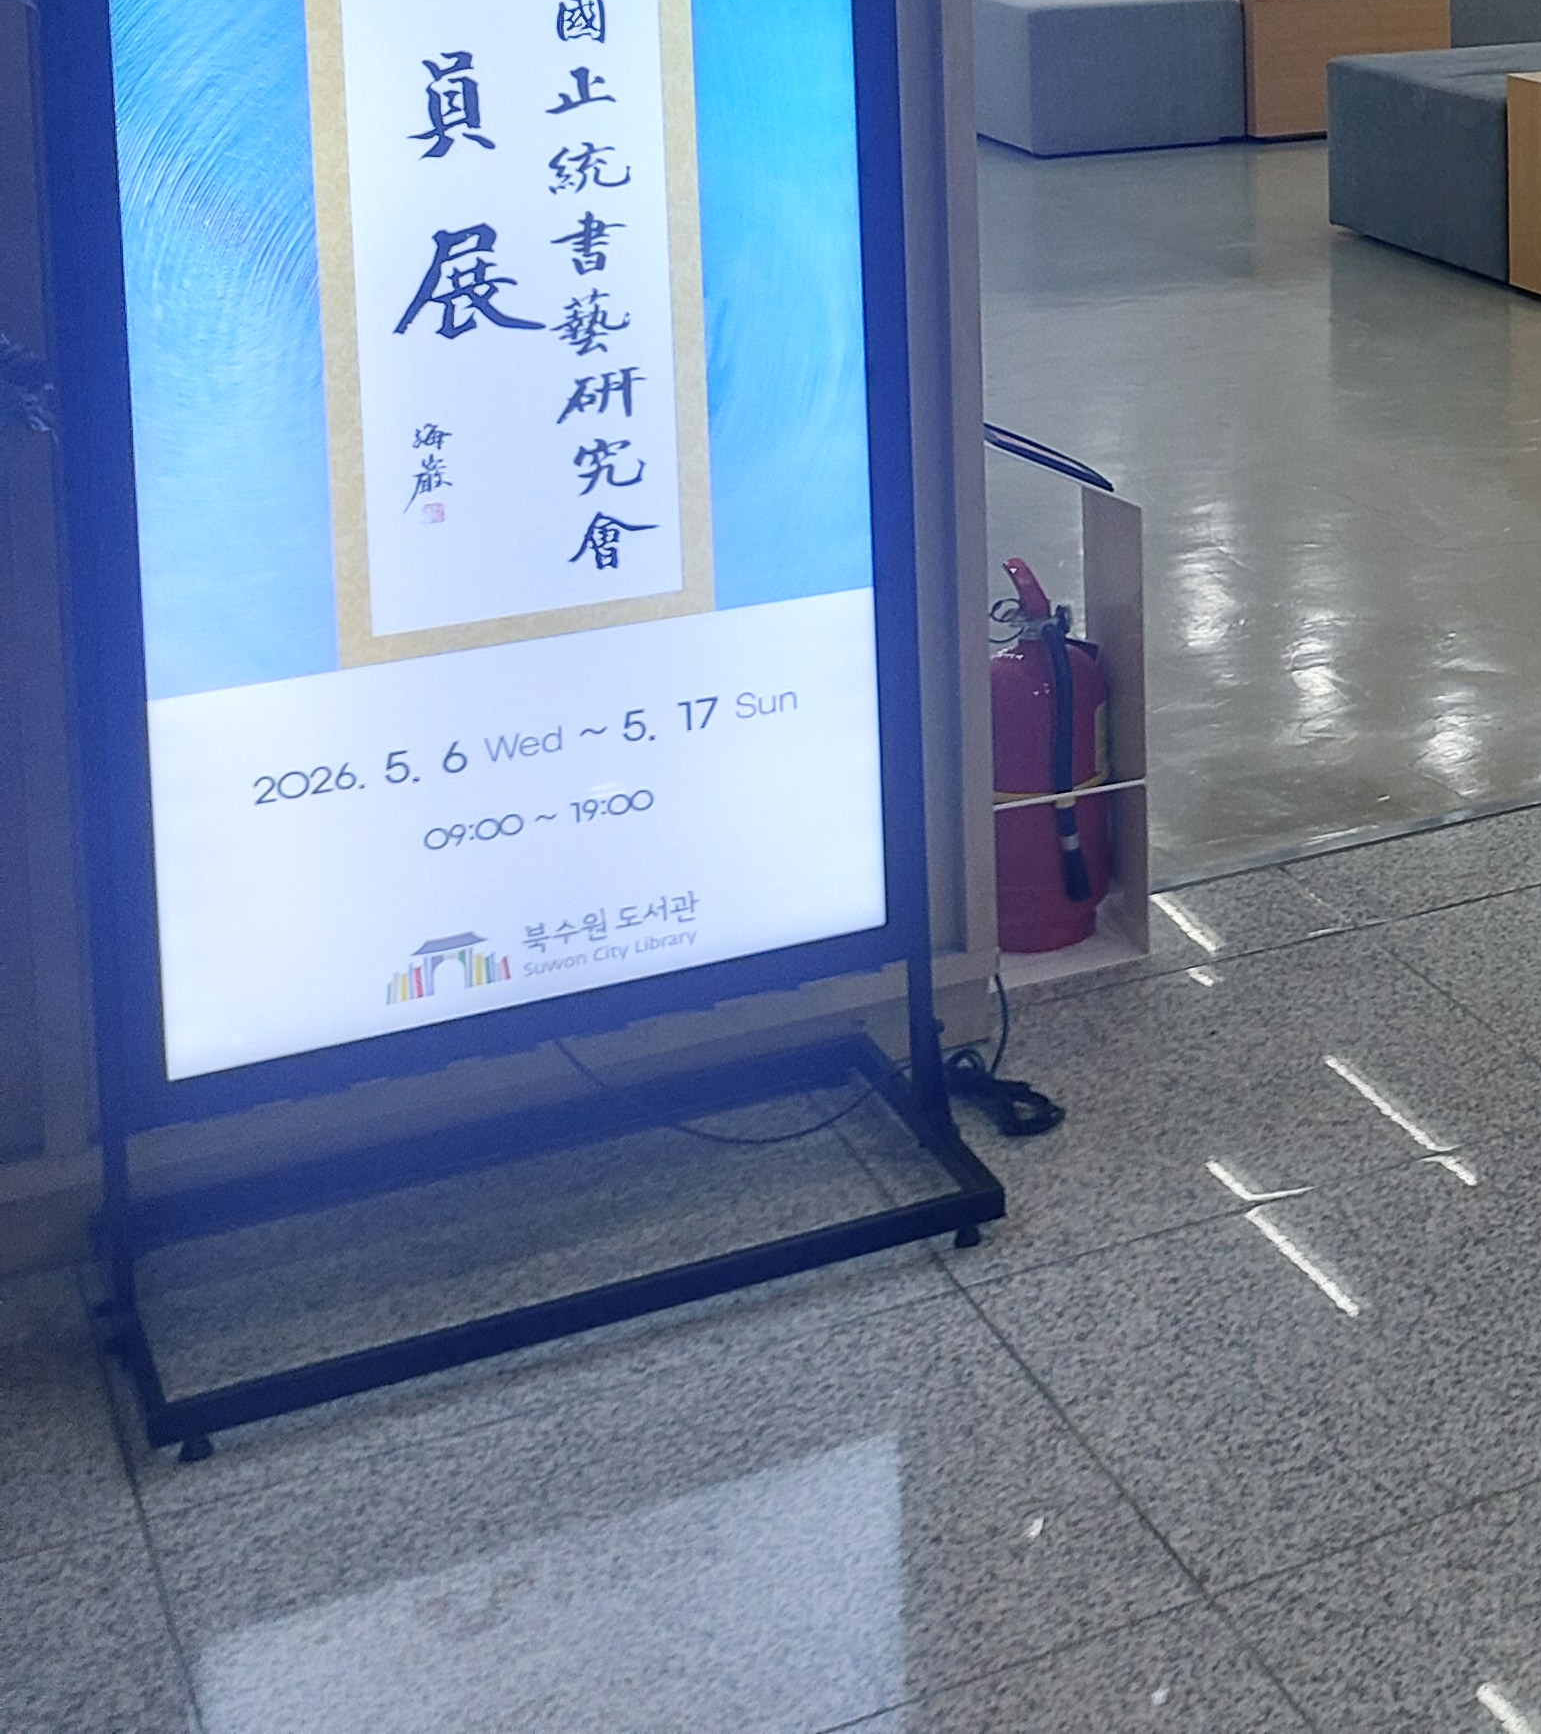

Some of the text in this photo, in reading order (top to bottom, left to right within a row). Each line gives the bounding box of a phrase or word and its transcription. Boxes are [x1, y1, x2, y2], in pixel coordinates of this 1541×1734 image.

[253, 762, 366, 805] 2026.
[384, 750, 420, 784] 5.
[442, 741, 468, 774] 6
[484, 726, 563, 763] Wed
[622, 709, 656, 742] 5.
[678, 696, 719, 732] 17
[735, 690, 798, 720] Sun
[423, 813, 525, 851] 09:00
[570, 789, 655, 824] 19:00
[523, 890, 700, 953] 북수원 도서관
[523, 930, 698, 978] Suwon City Library
